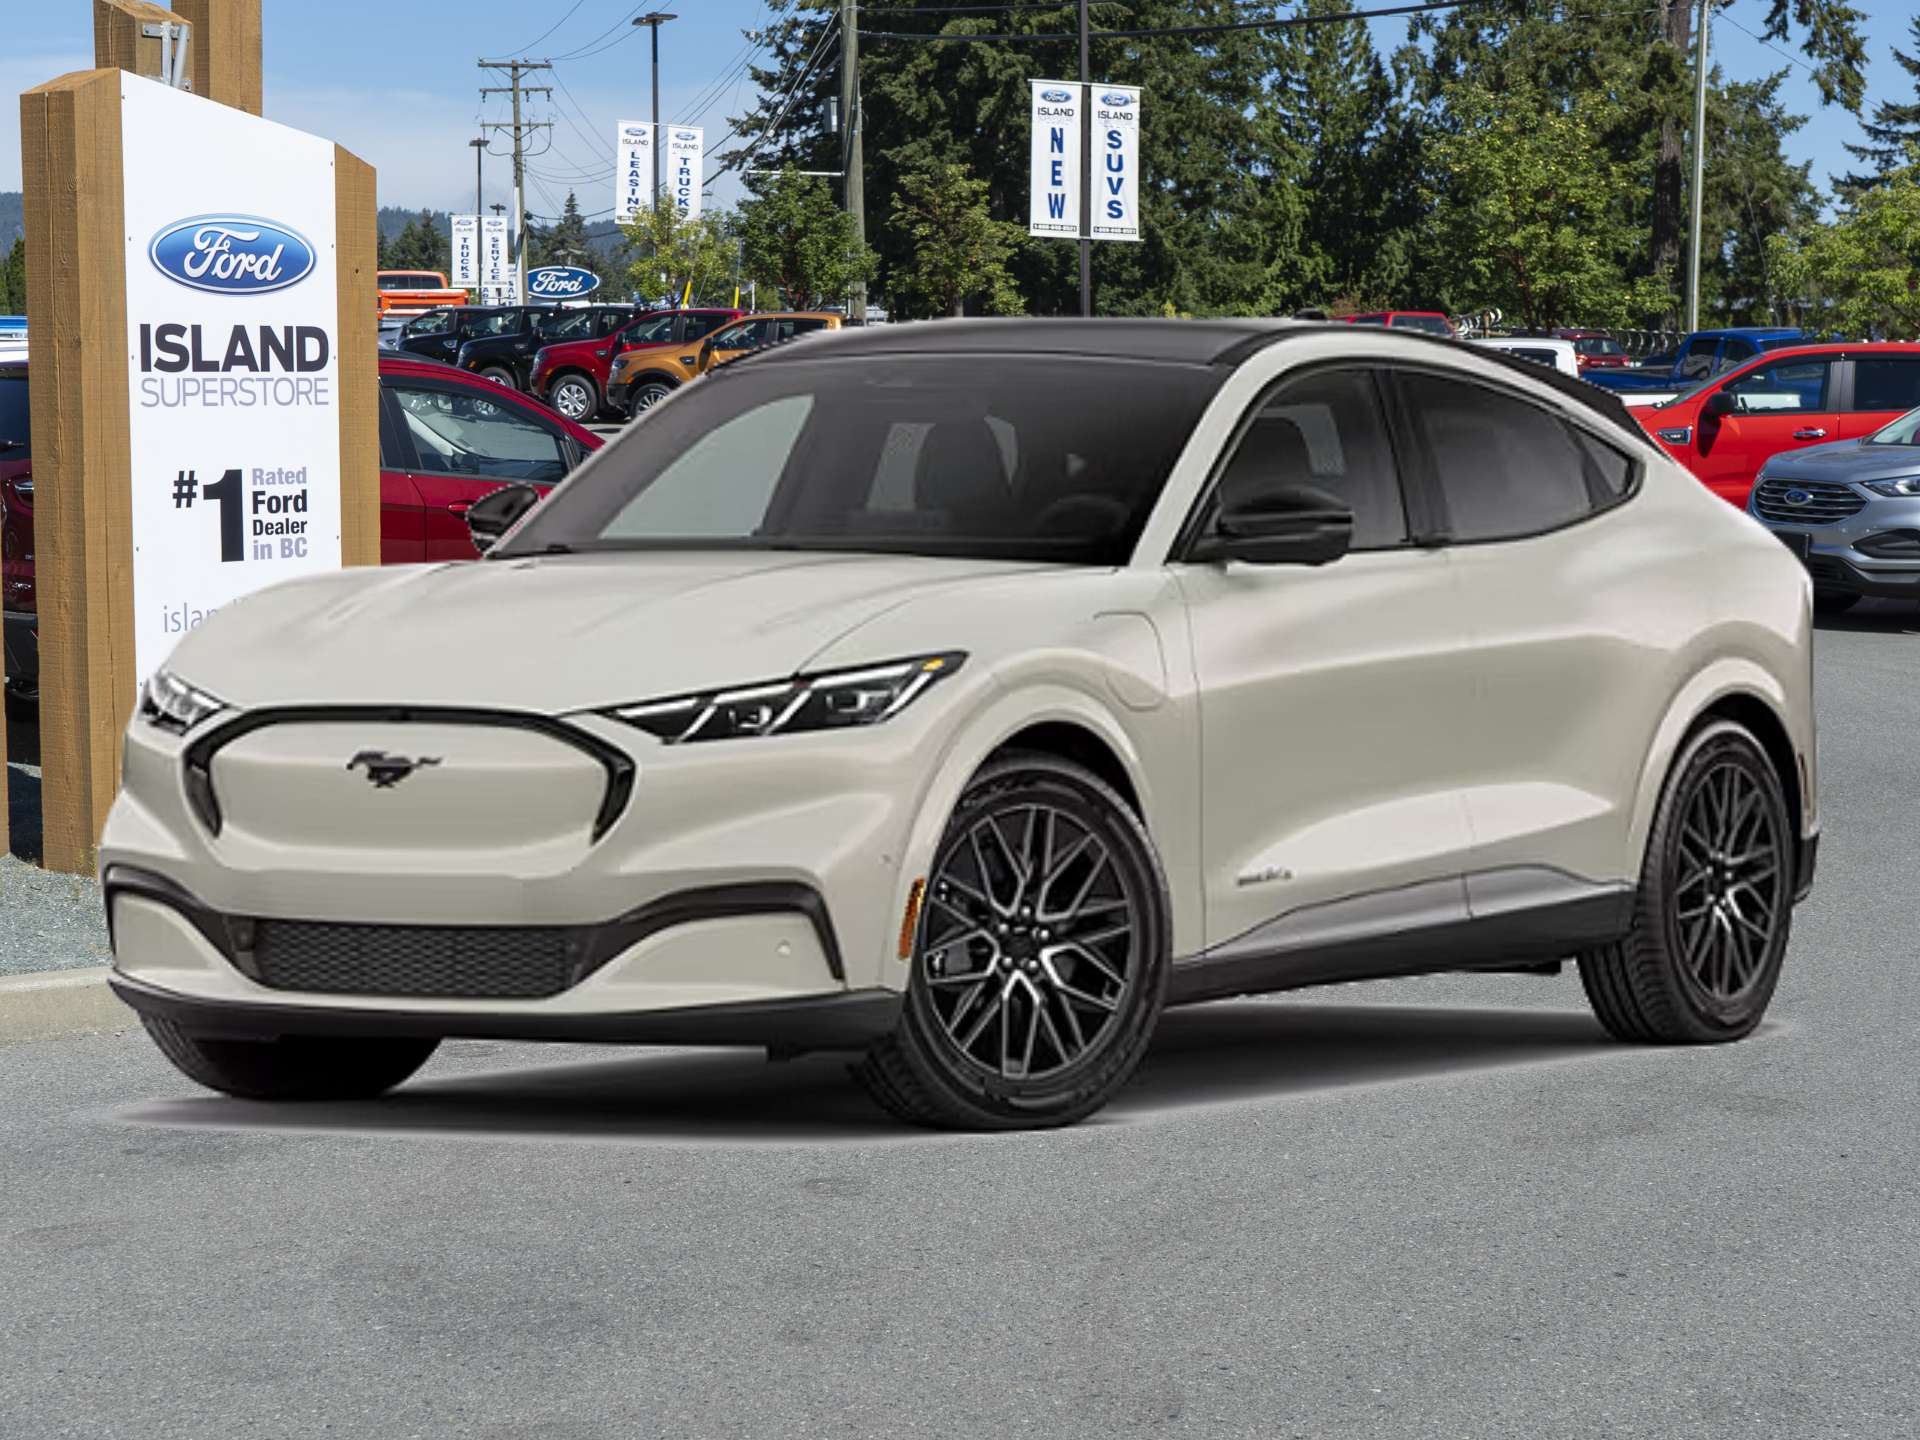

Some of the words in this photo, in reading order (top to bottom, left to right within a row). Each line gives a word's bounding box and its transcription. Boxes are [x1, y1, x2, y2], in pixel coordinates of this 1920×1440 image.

[1037, 107, 1075, 117] ISLAND
[1097, 110, 1133, 121] ISLAND
[622, 138, 649, 146] ISLAND
[672, 142, 699, 150] ISLAND
[1048, 127, 1066, 219] NEW
[1106, 130, 1124, 219] SUVS
[678, 157, 691, 218] TRUCKS
[183, 226, 284, 281] Ford
[461, 236, 470, 279] TRUCKS
[491, 236, 500, 280] SERVICE
[532, 270, 584, 292] Ford
[139, 323, 330, 373] ISLAND
[140, 377, 329, 408] SUPERSTORE
[252, 467, 307, 486] Rated
[252, 489, 308, 515] Ford
[252, 518, 308, 536] Dealer
[253, 539, 273, 561] in
[280, 537, 308, 559] BC
